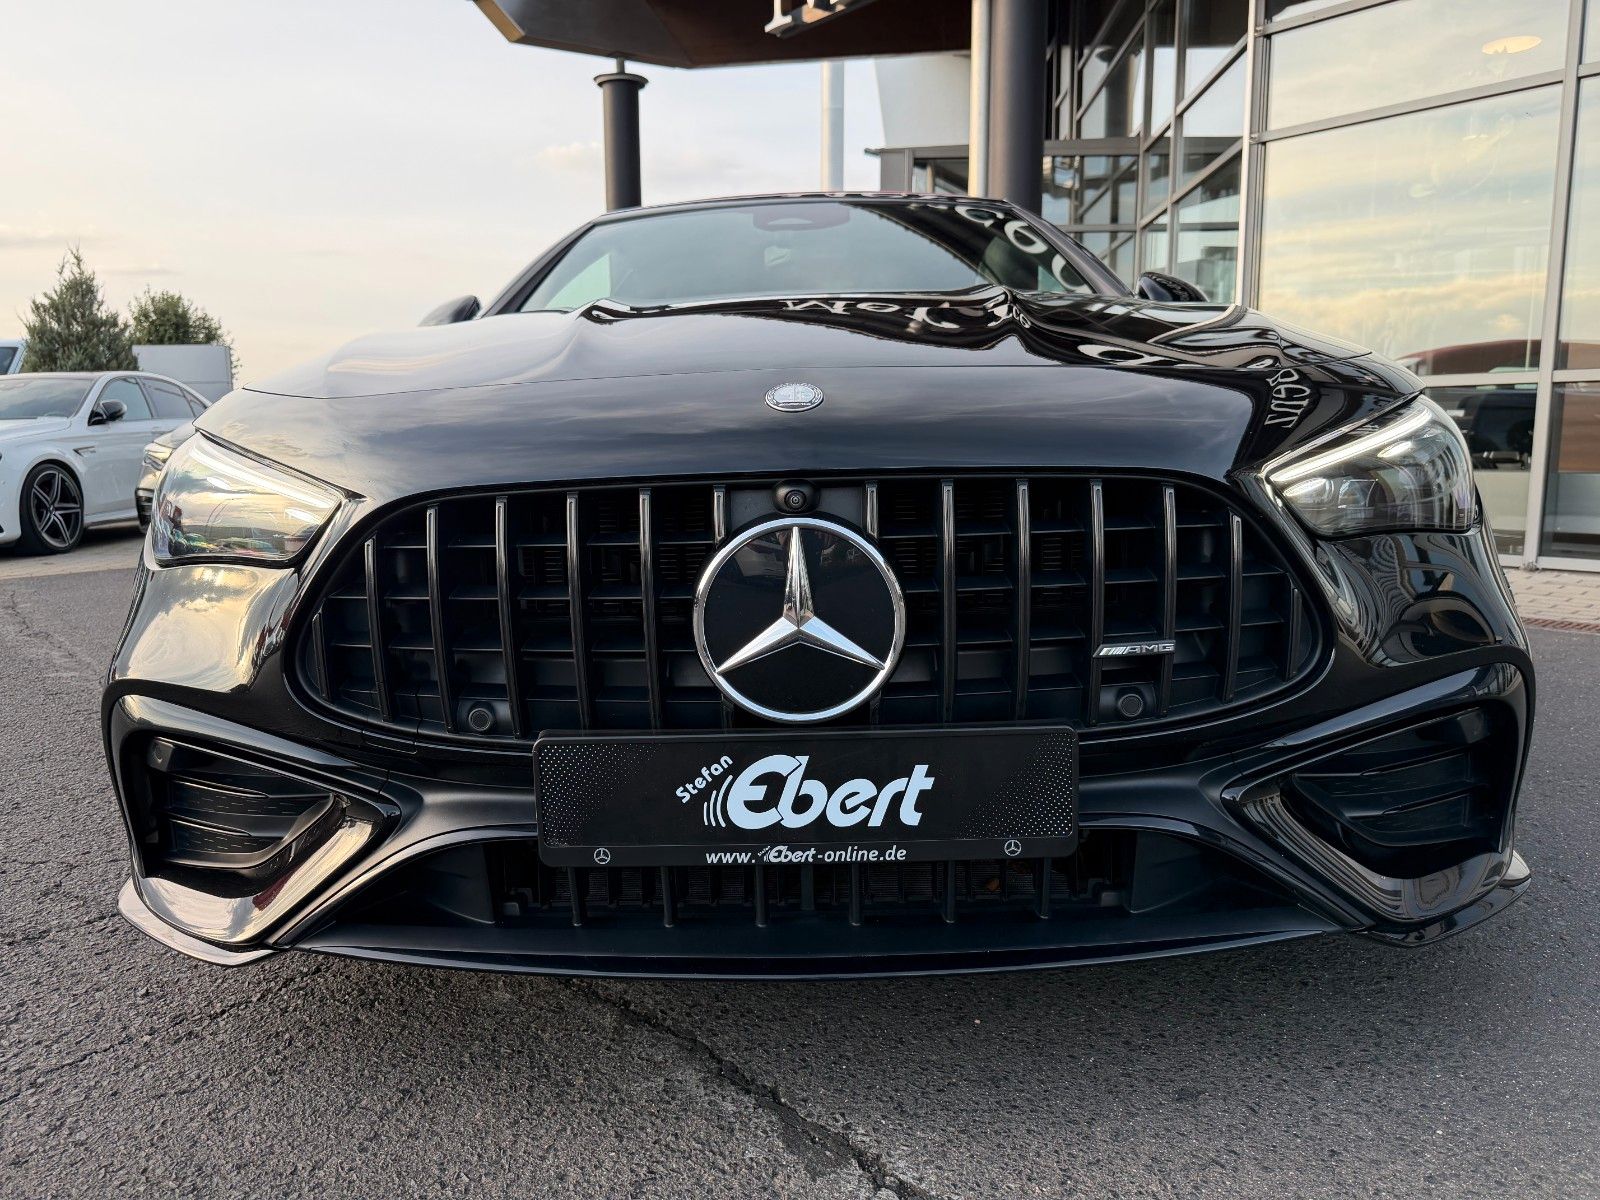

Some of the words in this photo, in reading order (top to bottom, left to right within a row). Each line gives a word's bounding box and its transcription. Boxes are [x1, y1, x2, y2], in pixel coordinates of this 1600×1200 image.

[1121, 643, 1175, 656] AMG
[675, 755, 733, 804] Stefan
[727, 754, 936, 829] Ebert
